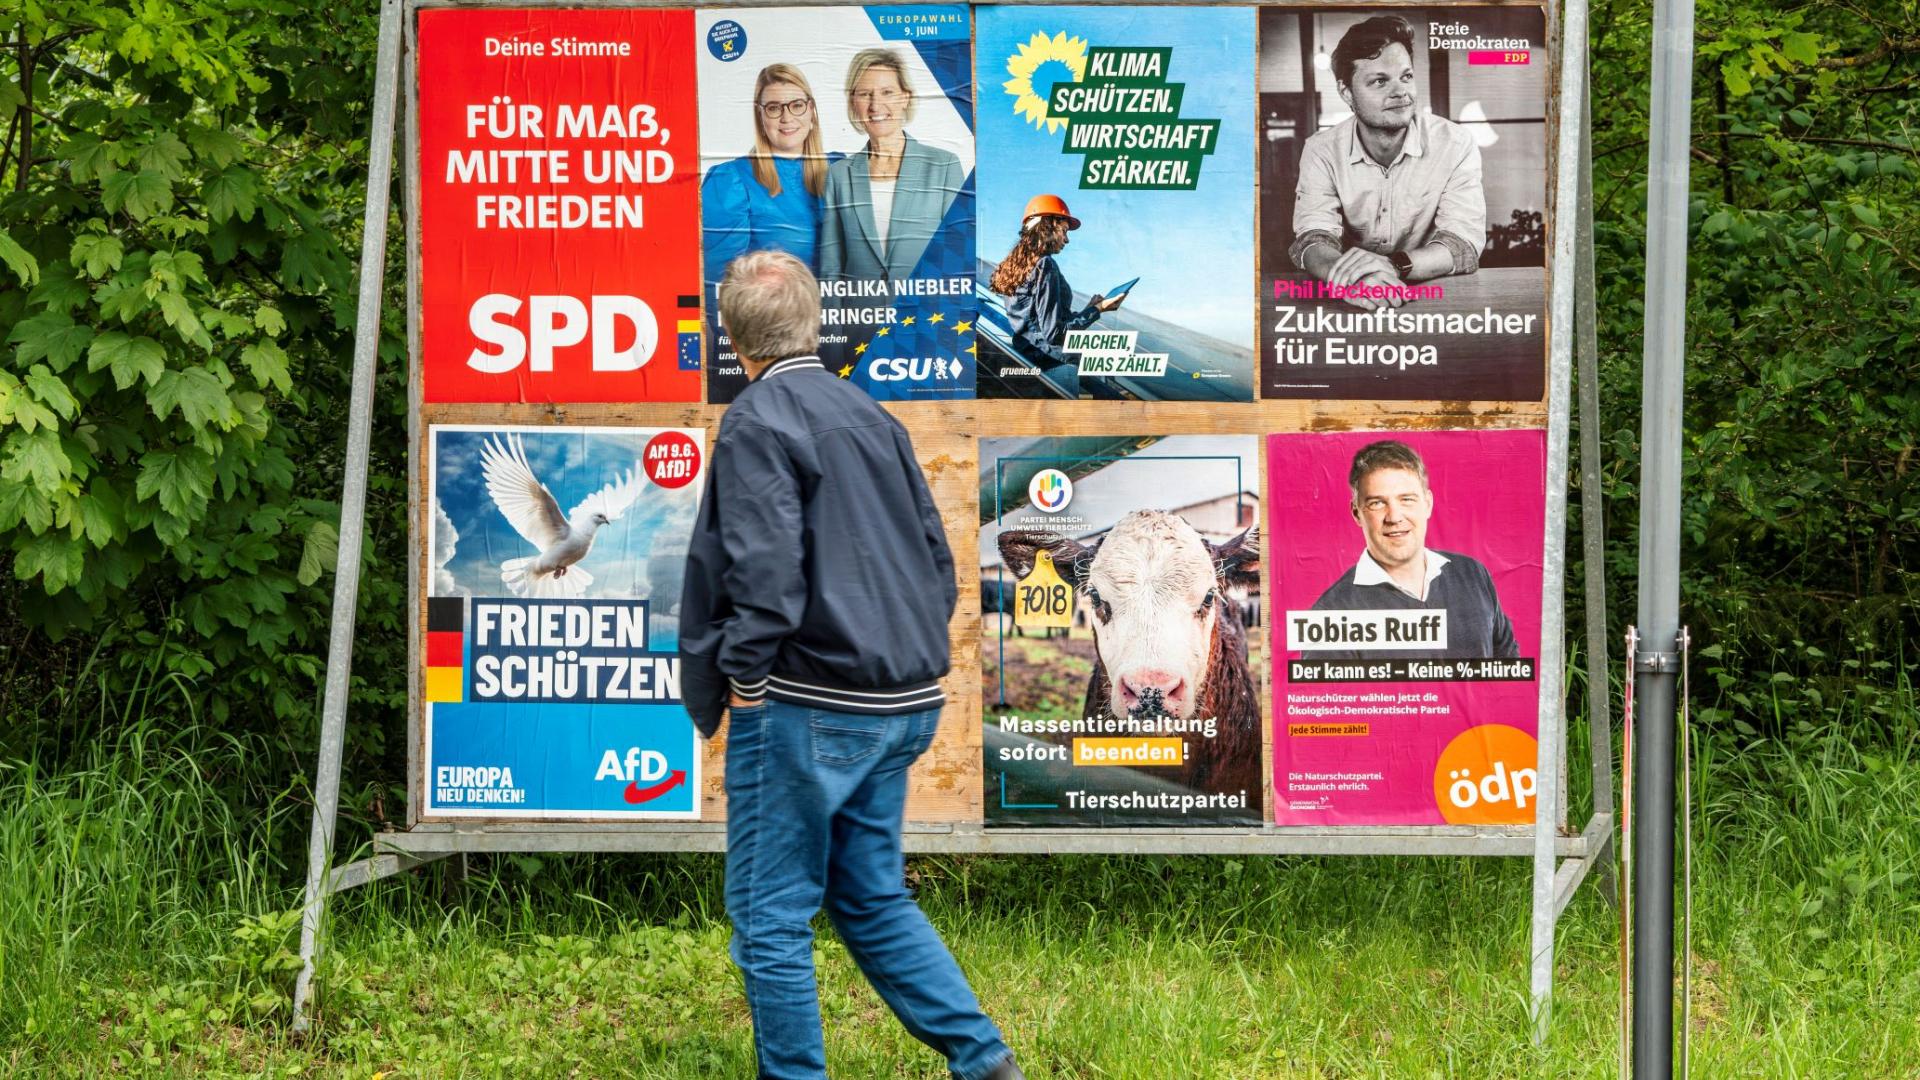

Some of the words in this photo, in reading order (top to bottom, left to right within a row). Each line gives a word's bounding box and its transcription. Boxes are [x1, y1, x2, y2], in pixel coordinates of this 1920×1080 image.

[879, 14, 963, 24] EUROPAWAHL
[1429, 22, 1470, 36] Freie
[904, 26, 913, 36] 9.
[916, 26, 938, 37] JUNI
[485, 38, 544, 57] Deine
[551, 38, 631, 57] Stimme
[1429, 36, 1530, 50] Demokraten
[1090, 53, 1161, 77] KLIMA
[1504, 53, 1528, 63] FDP
[1054, 83, 1173, 113] SCHÜTZEN.
[467, 96, 545, 138] FÜR
[1071, 124, 1213, 149] WIRTSCHAFT
[446, 150, 569, 183] MITTE
[583, 150, 674, 184] UND
[1087, 155, 1192, 184] STÄRKEN.
[477, 195, 643, 229] FRIEDEN
[820, 279, 889, 297] NGLIKA
[895, 278, 973, 296] NIEBLER
[1274, 279, 1313, 299] Phil
[1318, 280, 1444, 300] Hackemann
[820, 307, 898, 326] HRINGER
[1274, 306, 1537, 334] Zukunftsmacher
[466, 293, 659, 374] SPD
[1067, 334, 1131, 352] MACHEN,
[1083, 357, 1113, 372] WAS
[1116, 354, 1162, 373] ZÄHLT.
[1274, 338, 1319, 365] für
[1325, 338, 1438, 370] Europa
[719, 366, 742, 375] nach
[869, 357, 932, 381] CSU
[1000, 366, 1042, 377] gruene.de
[649, 444, 668, 459] AM
[671, 443, 695, 458] 9.6.
[655, 459, 691, 479] AfD!
[1020, 584, 1067, 616] 7018
[476, 604, 644, 648] FRIEDEN
[1294, 616, 1377, 643] Tobias
[1385, 615, 1440, 642] Ruff
[475, 650, 681, 700] SCHÜTZEN
[1292, 664, 1321, 679] Der
[1325, 663, 1364, 679] kann
[1369, 663, 1391, 678] es!
[1409, 662, 1454, 678] Keine
[1457, 661, 1531, 678] %-Hürde
[1288, 694, 1357, 703] Naturschützer
[1360, 693, 1396, 702] wählen
[1397, 693, 1421, 704] jetzt
[1423, 692, 1439, 702] die
[1287, 705, 1418, 717] Ökologisch-Demokratische
[1421, 705, 1450, 714] Partei
[1000, 715, 1217, 738] Massentierhaltung
[1290, 726, 1309, 736] Jede
[1310, 726, 1342, 734] Stimme
[1344, 725, 1367, 734] zählt!
[1000, 743, 1067, 761] sofort
[595, 747, 668, 781] AfD
[437, 766, 514, 788] EUROPA
[1289, 783, 1336, 791] Erstaunlich
[1338, 783, 1370, 791] ehrlich.
[1305, 772, 1384, 782] Naturschutzpartei.
[1450, 762, 1537, 809] ödp
[437, 788, 464, 803] NEU
[467, 788, 525, 803] DENKEN!
[1066, 790, 1246, 813] Tierschutzpartei
